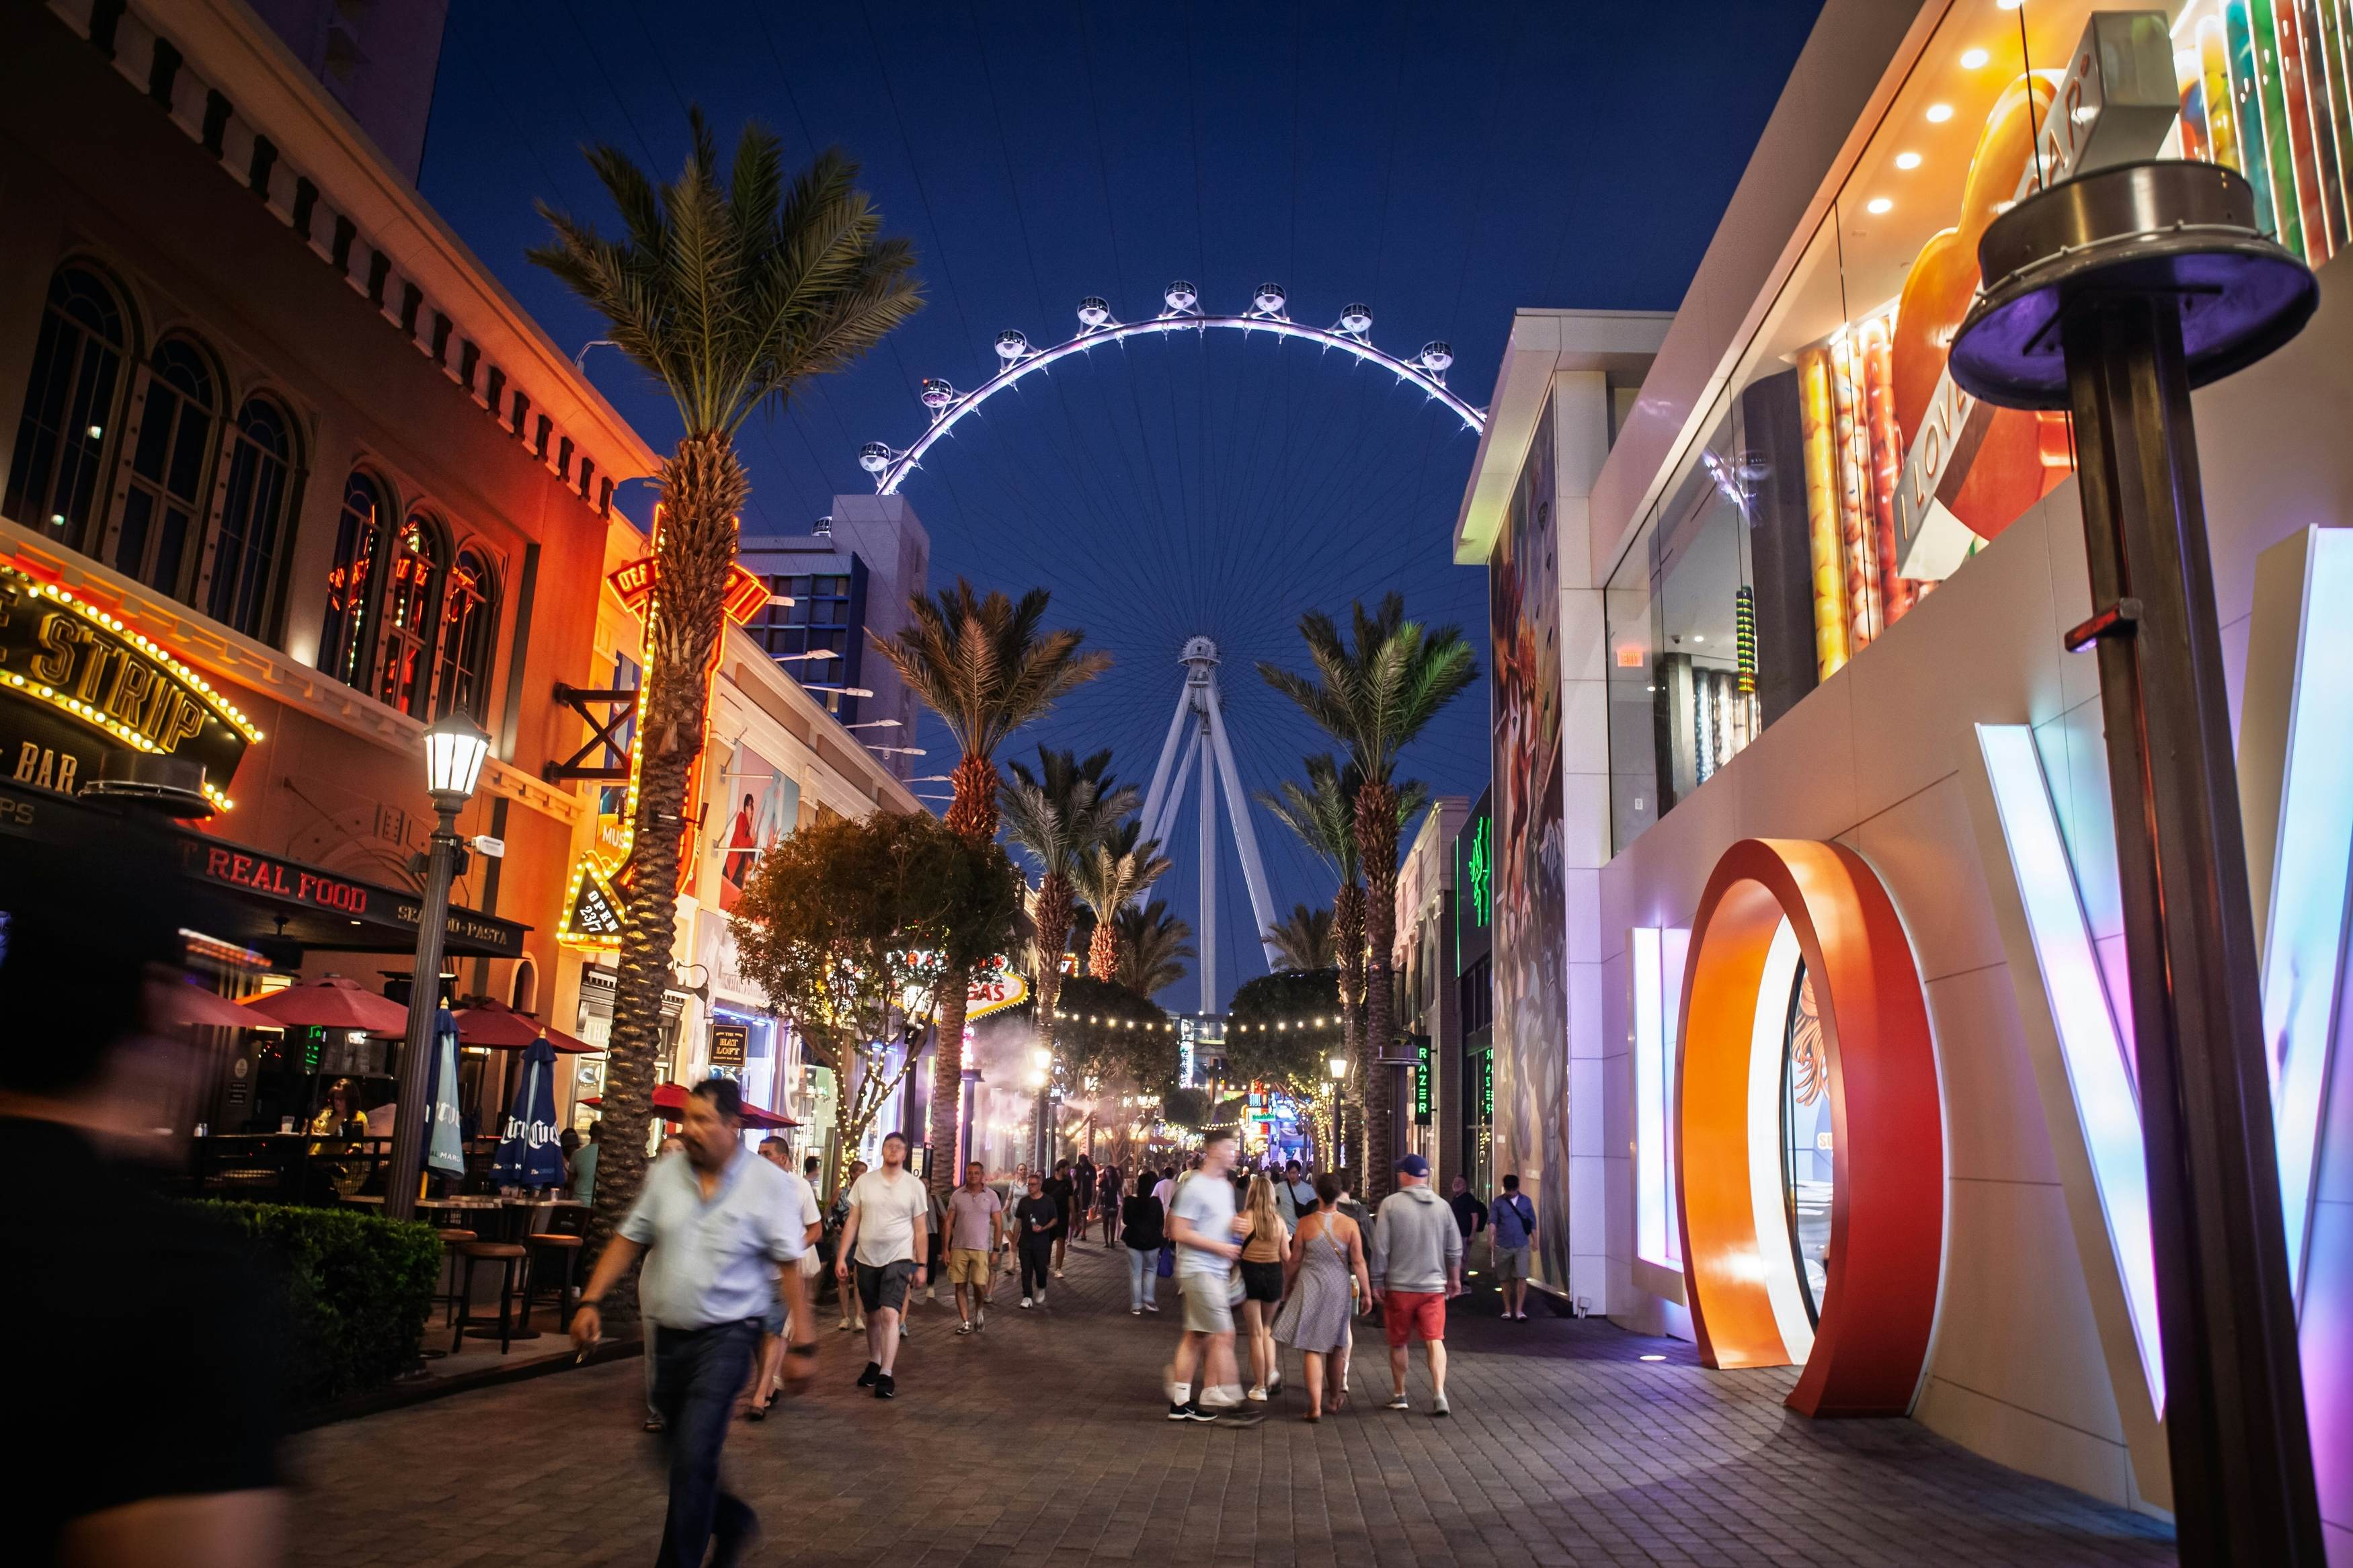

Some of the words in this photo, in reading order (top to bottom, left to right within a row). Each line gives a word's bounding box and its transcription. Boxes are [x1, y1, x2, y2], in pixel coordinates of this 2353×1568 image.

[30, 611, 206, 753] STRIP
[13, 741, 78, 796] BAR
[205, 847, 290, 896] REAL
[297, 872, 366, 914] FOOD
[580, 905, 602, 932] 23/7
[588, 890, 619, 933] OPEN
[467, 921, 508, 946] PASTA
[587, 1022, 610, 1041] THE
[719, 1038, 739, 1046] HAT
[716, 1046, 740, 1055] LOFT
[1419, 1047, 1428, 1114] RAZER
